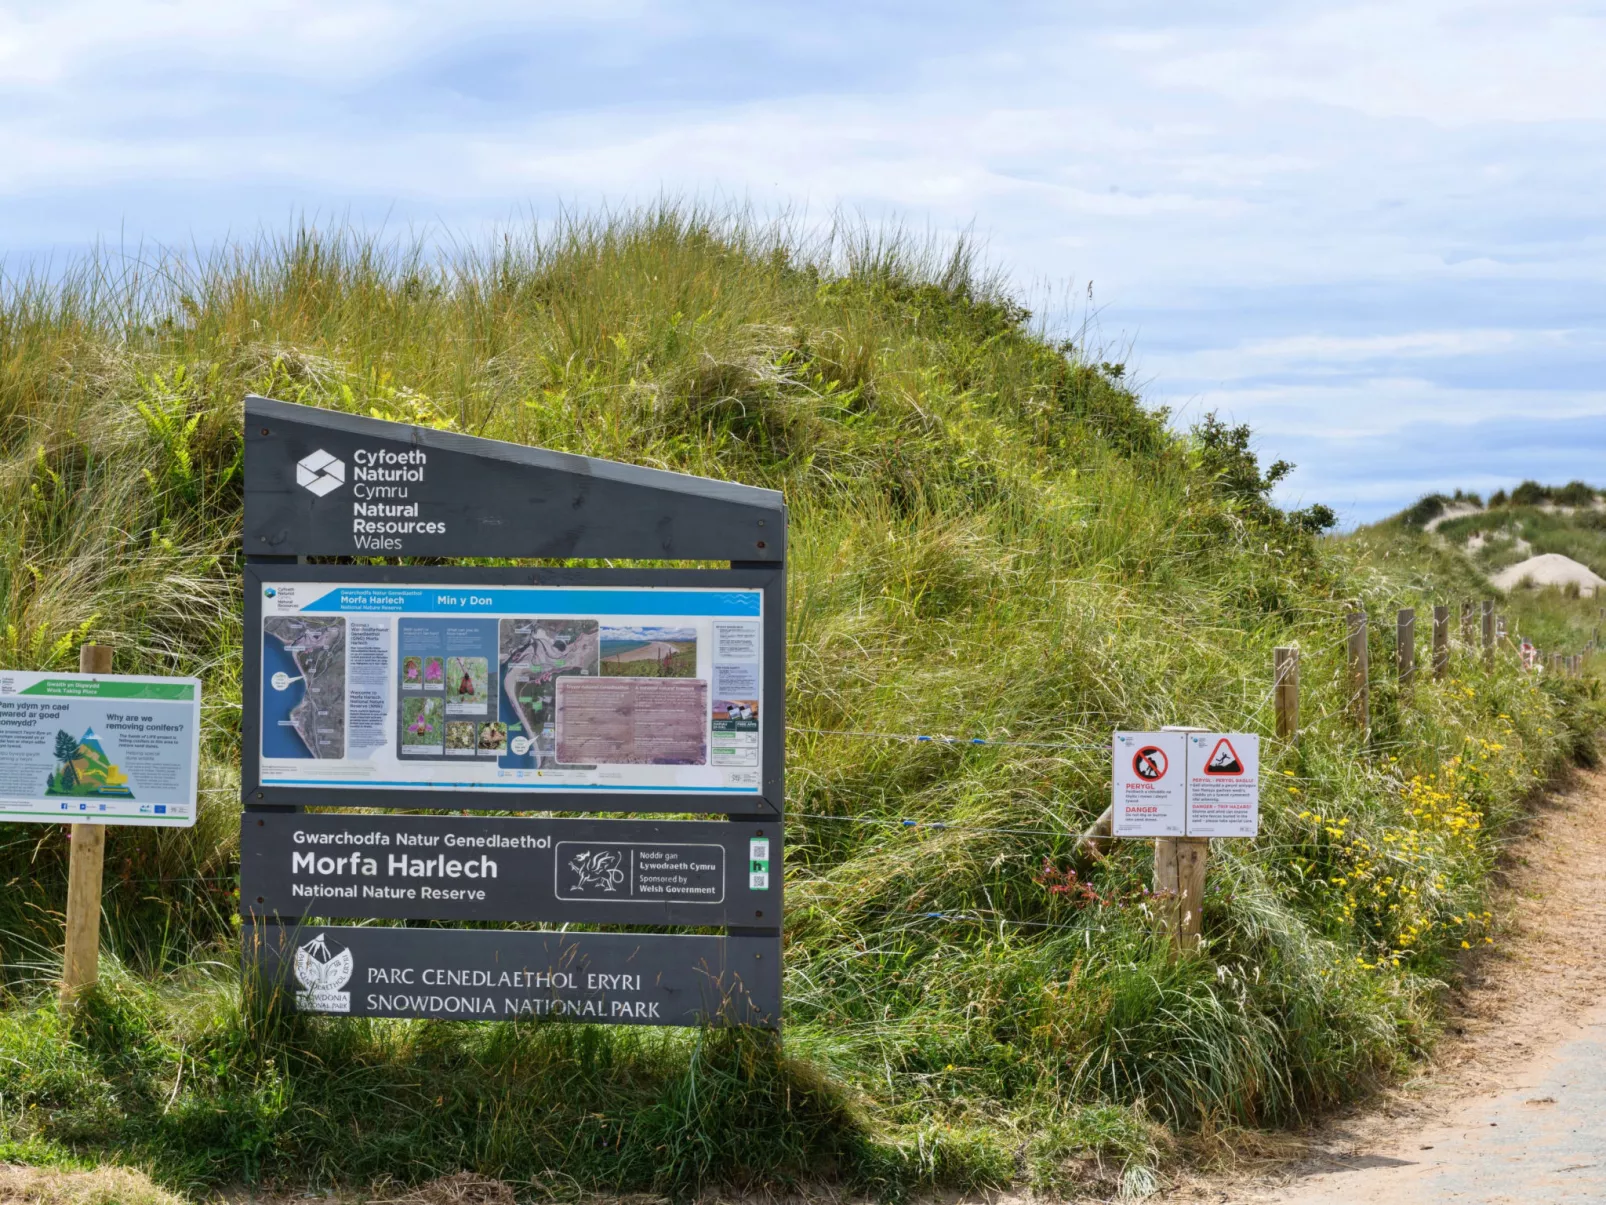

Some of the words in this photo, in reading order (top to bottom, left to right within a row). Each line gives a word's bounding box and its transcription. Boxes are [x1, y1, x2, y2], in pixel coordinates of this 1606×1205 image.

[353, 449, 427, 467] Cyfoeth
[353, 465, 424, 482] Naturiol
[353, 483, 408, 500] Cymru
[353, 502, 418, 517] Natural
[353, 519, 446, 534] Resources
[353, 534, 402, 550] Wales
[340, 596, 367, 604] Morfa
[370, 596, 404, 604] Harlech
[437, 596, 457, 605] Min
[460, 598, 466, 606] y
[470, 596, 492, 605] Don
[16, 703, 38, 711] ydym
[39, 712, 60, 720] goed
[106, 714, 124, 722] Why
[0, 719, 37, 727] onwydd?
[106, 722, 144, 732] removing
[146, 724, 184, 732] conifers?
[293, 830, 390, 845] Gwarchodfa
[396, 833, 440, 846] Natur
[444, 834, 551, 849] Genedlaethol
[640, 852, 663, 860] Noddir
[292, 852, 377, 875] Morfa
[388, 854, 498, 878] Harlech
[640, 862, 688, 870] Lywodraeth
[690, 863, 716, 872] Cymru
[640, 875, 677, 884] Sponsored
[678, 876, 687, 884] by
[292, 884, 357, 898] National
[362, 885, 416, 899] Nature
[421, 886, 486, 900] Reserve
[640, 885, 664, 893] Welsh
[666, 885, 716, 894] Government
[367, 967, 414, 985] PARC
[422, 969, 577, 989] CENEDLAETHOL
[588, 973, 641, 990] ERYRI
[367, 994, 496, 1014] SNOWDONIA
[505, 998, 607, 1017] NATIONAL
[611, 1001, 660, 1018] PARK
